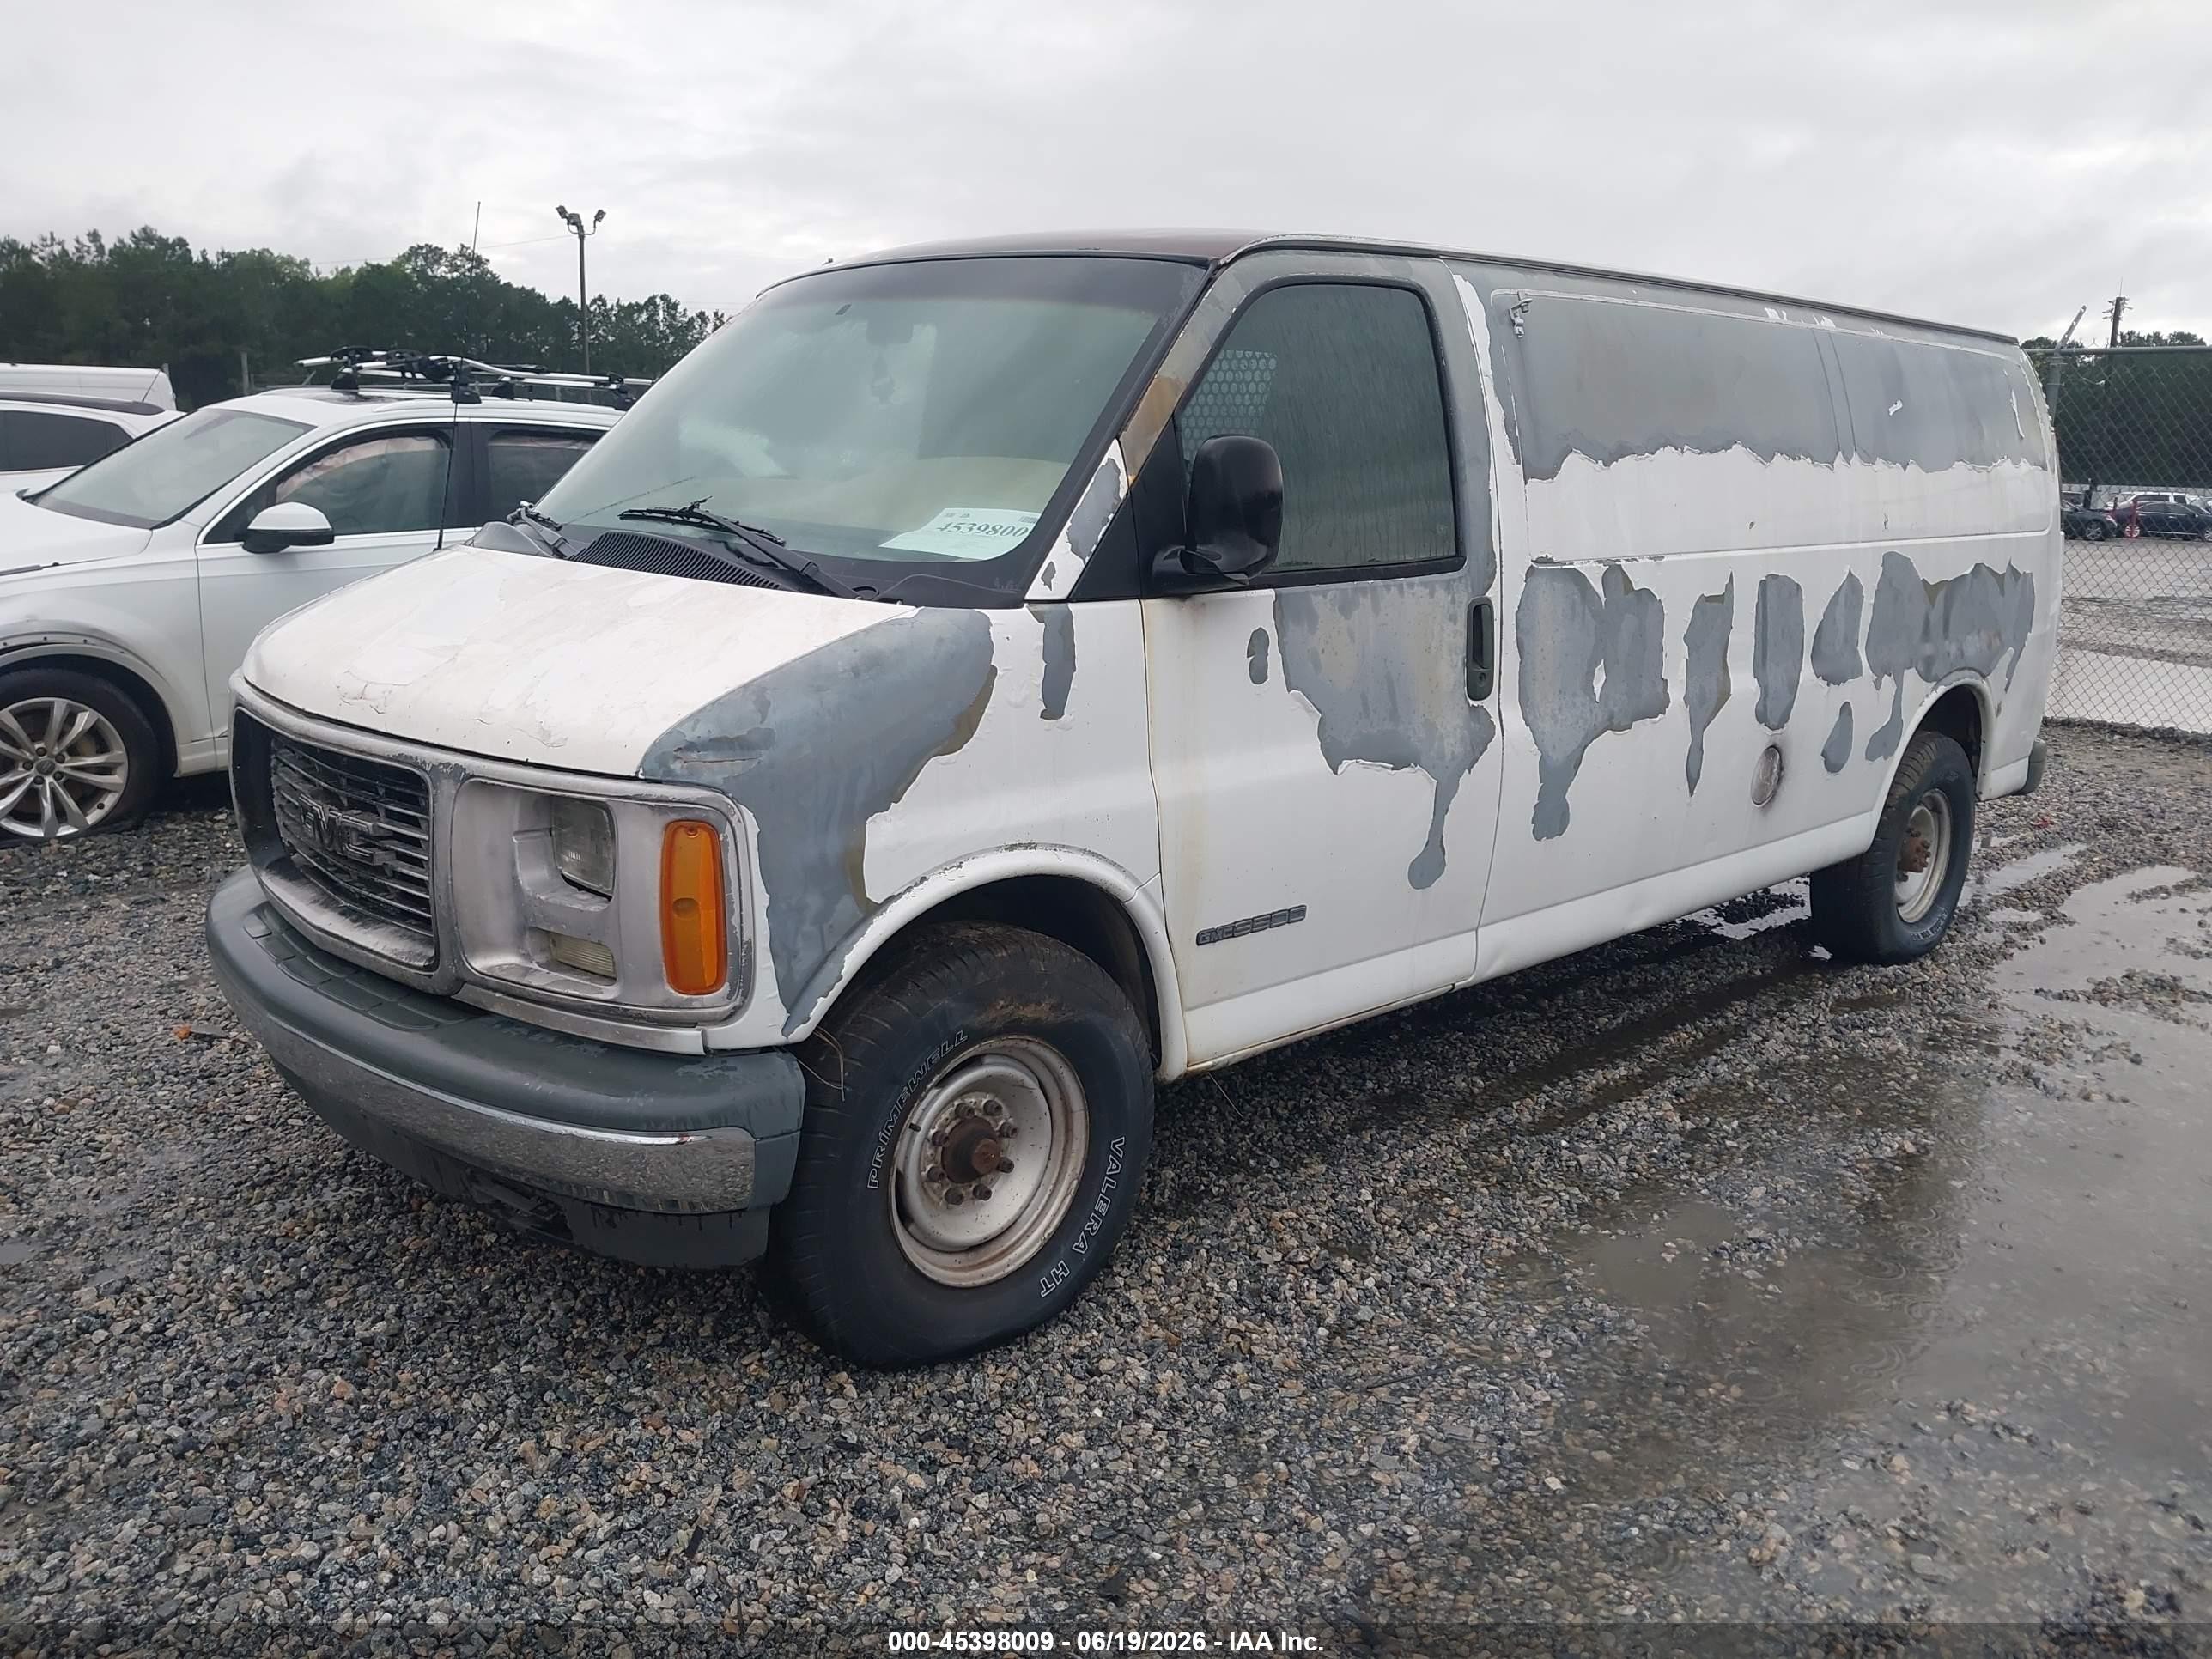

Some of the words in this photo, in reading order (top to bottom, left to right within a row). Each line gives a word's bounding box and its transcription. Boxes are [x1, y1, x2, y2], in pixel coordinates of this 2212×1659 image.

[867, 1030, 969, 1189] PRIMEWELL
[1072, 1135, 1126, 1255] VALERA
[1039, 1260, 1071, 1297] HT
